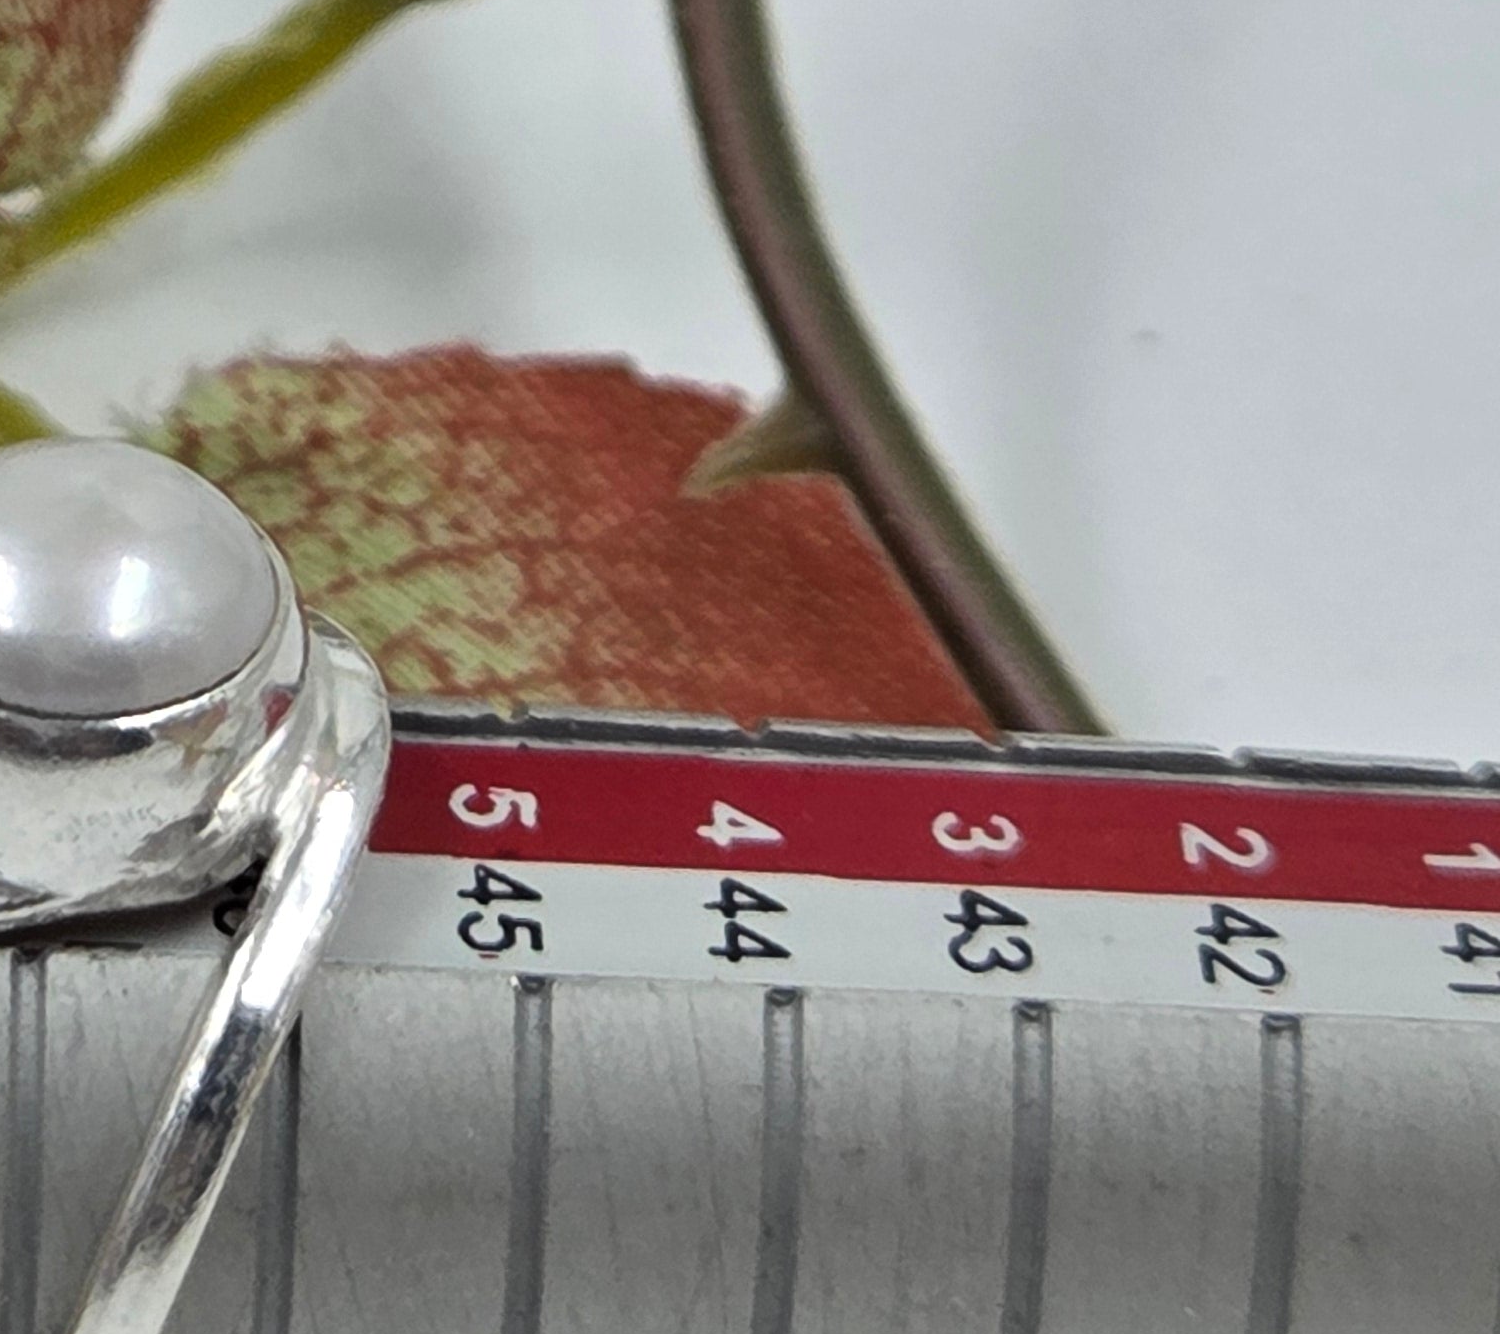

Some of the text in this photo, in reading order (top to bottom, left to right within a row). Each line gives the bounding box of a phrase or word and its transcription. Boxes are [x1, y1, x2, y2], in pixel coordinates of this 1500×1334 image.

[448, 783, 543, 955] 5 45
[696, 800, 792, 962] 4 44
[932, 812, 1034, 973] 3 43
[1180, 823, 1288, 985] 2 42
[1423, 842, 1500, 870] 1
